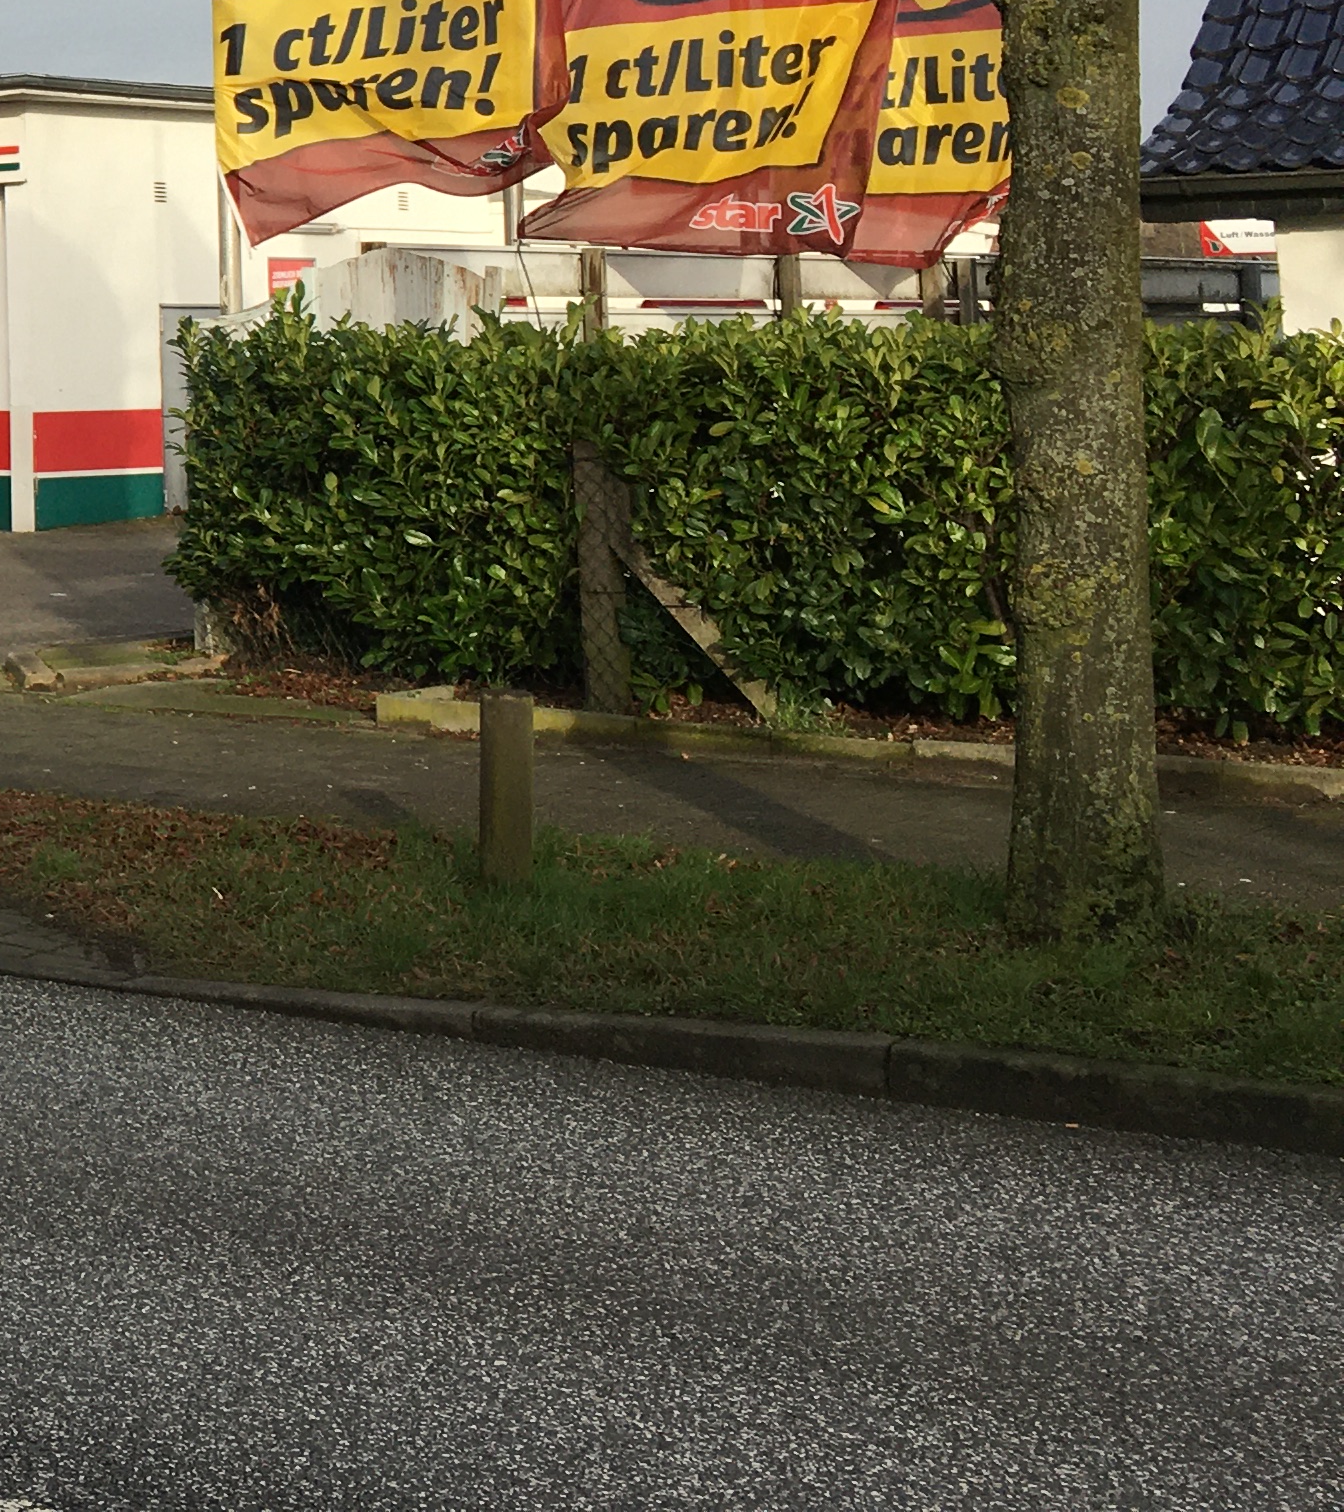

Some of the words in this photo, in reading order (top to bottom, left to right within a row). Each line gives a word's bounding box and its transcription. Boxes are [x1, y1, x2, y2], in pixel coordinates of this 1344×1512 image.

[219, 23, 247, 76] 1
[568, 54, 588, 105] 1
[605, 29, 838, 100] ct/Liter
[233, 53, 502, 139] sparen!
[567, 82, 815, 174] sparen!
[689, 193, 782, 233] star
